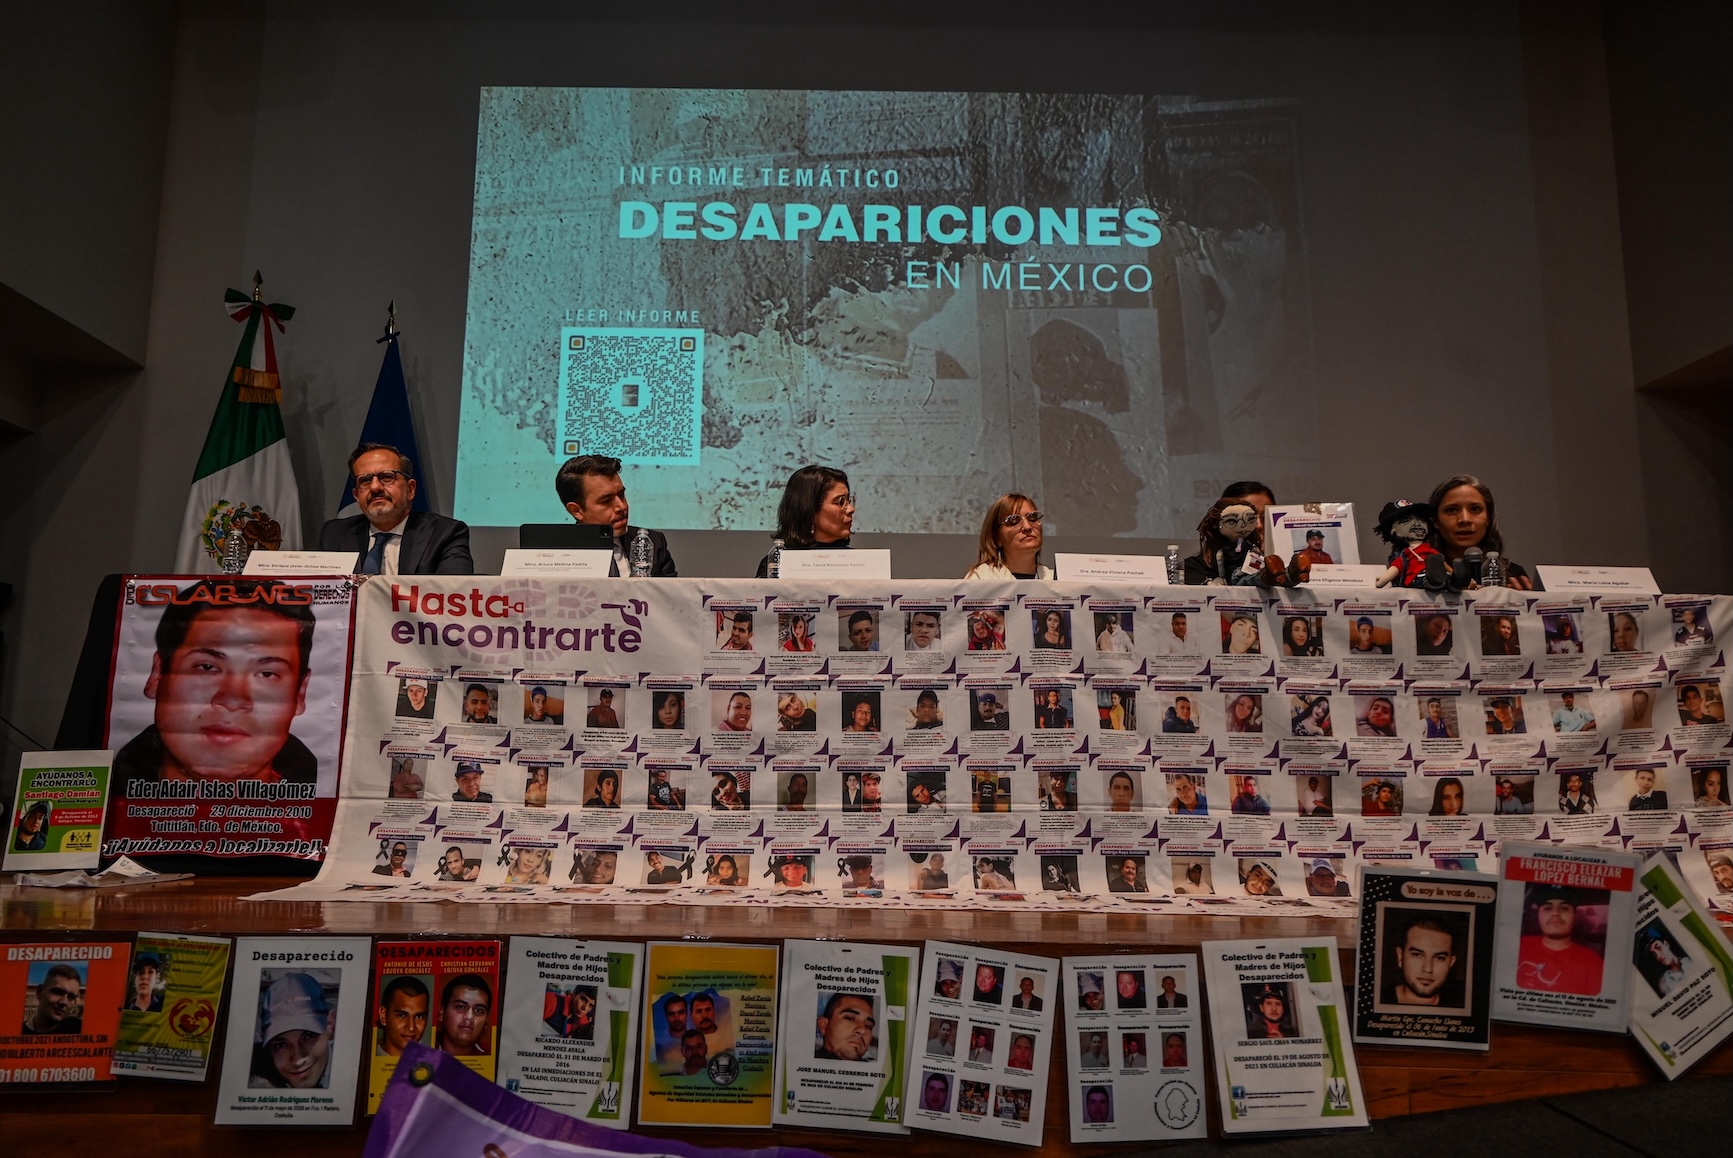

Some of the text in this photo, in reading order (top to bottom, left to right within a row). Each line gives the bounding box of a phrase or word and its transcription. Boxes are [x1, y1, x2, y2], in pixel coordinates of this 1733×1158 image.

[619, 163, 900, 190] INFORME TEMÁTICO
[618, 201, 1163, 247] DESAPARICIONES
[906, 257, 1154, 293] EN MÉXICO
[565, 309, 700, 323] LEER INFORME
[391, 583, 510, 618] Hasta
[391, 619, 642, 653] encontrarte
[30, 779, 97, 788] ENCONTRARLO
[127, 779, 317, 801] Eder Adair Islas Villagómez
[24, 789, 102, 800] Santiago Damián
[209, 805, 226, 818] 29
[226, 805, 284, 818] diciembre
[285, 806, 312, 818] 2010
[150, 820, 284, 834] Tultitlán, Edo. de México.
[204, 842, 216, 853] a
[1520, 858, 1622, 878] FRANCISCO ELEAZAR
[1534, 870, 1606, 888] LOPEZ BERNAL
[1406, 884, 1476, 898] Yo soy la voz de
[7, 946, 113, 960] DESAPARECIDO
[252, 951, 354, 964] Desaparecido
[380, 945, 496, 958] DESAPARECIDOS
[526, 950, 568, 960] Colectivo
[584, 954, 614, 963] Padres
[616, 957, 622, 965] y
[1222, 953, 1264, 962] Colectivo
[538, 961, 570, 970] Madres
[586, 964, 608, 974] Hijos
[804, 963, 842, 973] Colectivo
[856, 967, 884, 976] Padres
[1235, 963, 1268, 971] Madres
[1283, 962, 1306, 970] Hijos
[538, 971, 605, 982] Desaparecidos
[814, 973, 844, 982] Madres
[858, 976, 880, 986] Hijos
[1238, 972, 1304, 982] Desaparecidos
[816, 982, 877, 994] Desaparecidos
[1650, 1000, 1673, 1018] MIGUEL
[1672, 988, 1690, 1002] DAVID
[46, 1048, 67, 1058] ARCE
[67, 1046, 114, 1058] ESCALANTE
[517, 1050, 556, 1059] DESAPARECIÓ
[1234, 1054, 1272, 1062] DESAPARECIÓ
[14, 1068, 39, 1082] 800
[40, 1066, 96, 1082] 6703600
[542, 1068, 586, 1076] INMEDIACIONES
[550, 1076, 578, 1084] CULIACÁN
